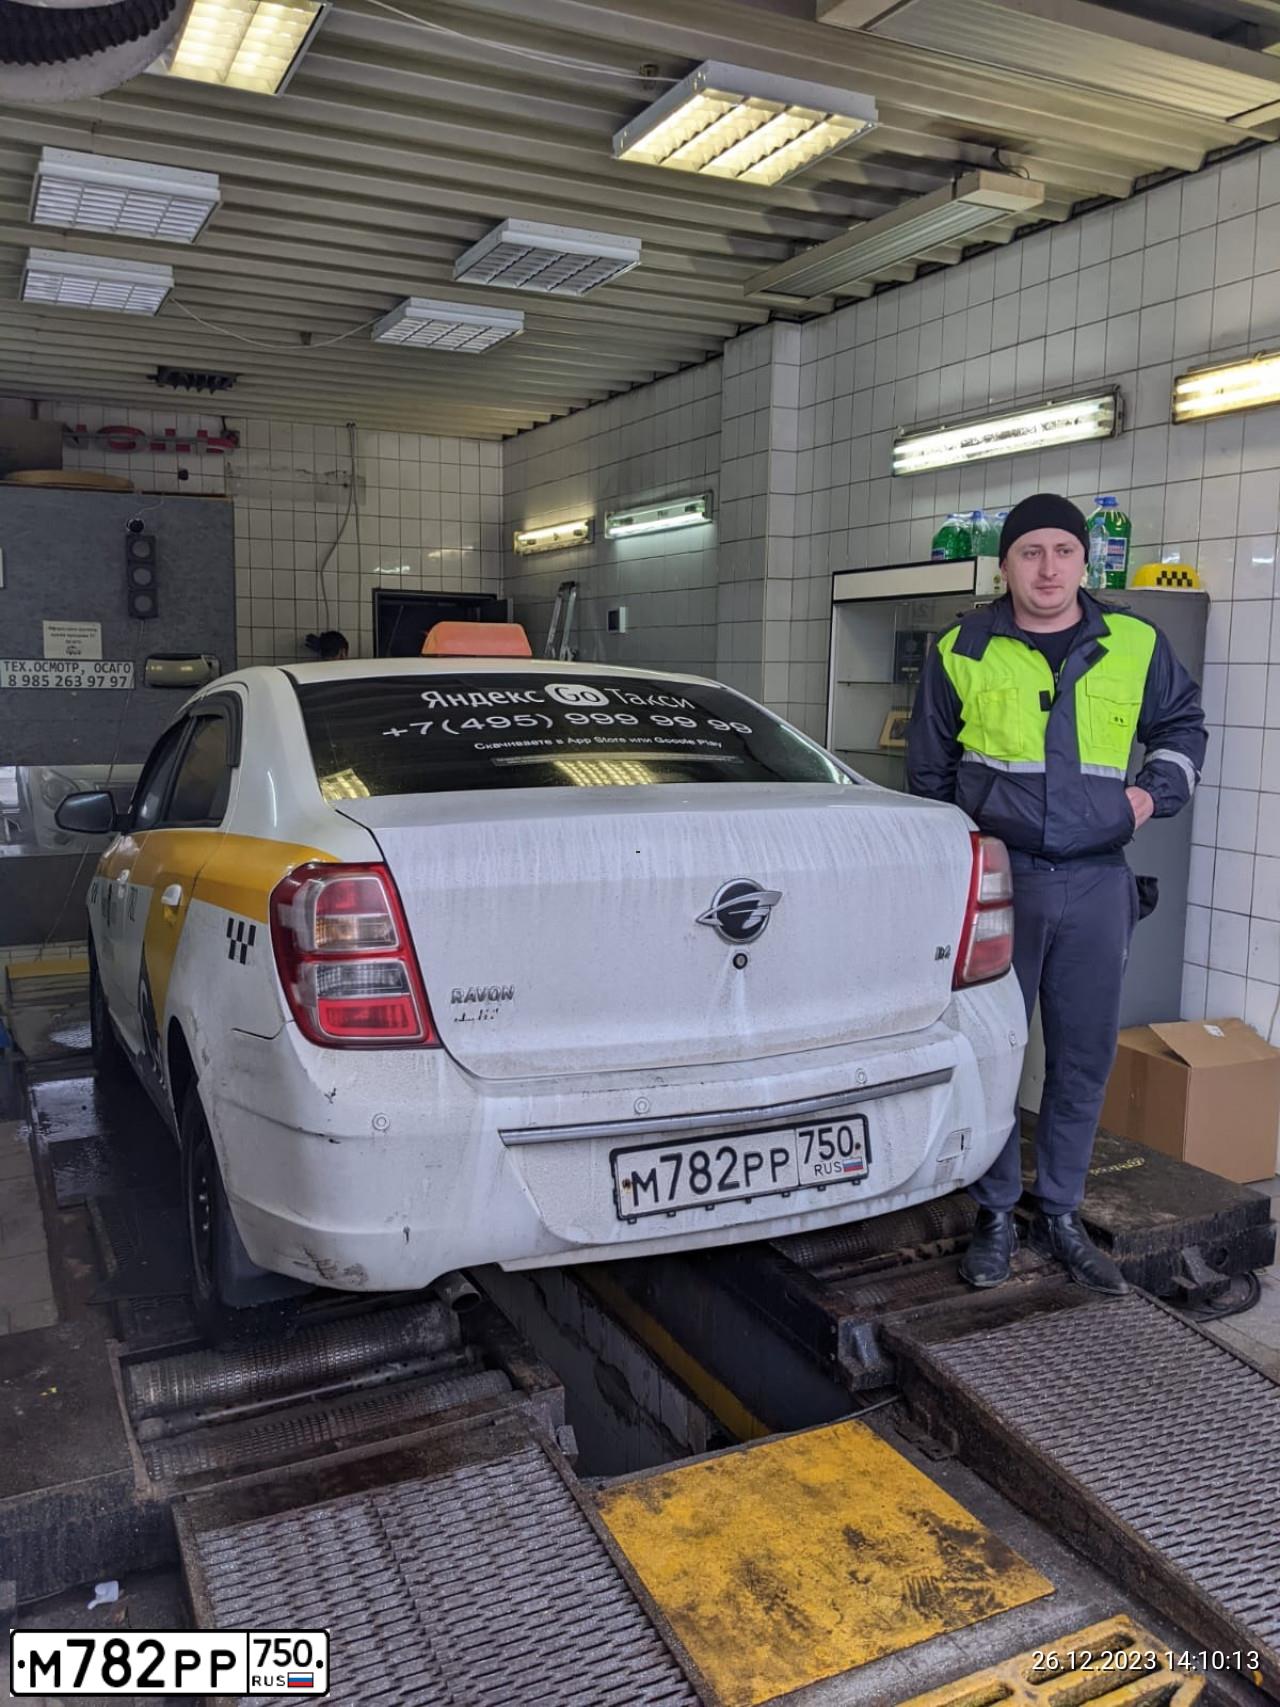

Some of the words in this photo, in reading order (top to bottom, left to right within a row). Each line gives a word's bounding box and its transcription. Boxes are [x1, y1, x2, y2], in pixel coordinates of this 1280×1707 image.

[4, 661, 86, 675] ТЕХ.ОСМОТР,
[94, 663, 131, 674] ОСАГО
[9, 675, 17, 687] 8
[22, 675, 49, 687] 985
[55, 675, 82, 687] 263
[88, 675, 104, 688] 97
[110, 675, 127, 688] 97
[420, 690, 545, 709] Яндекс
[553, 685, 601, 705] Go
[603, 687, 696, 710] Такси
[382, 713, 554, 737] +7(495)
[564, 712, 639, 725] 999
[650, 714, 698, 728] 99
[707, 718, 753, 734] 99
[567, 737, 592, 745] App
[593, 736, 627, 744] Store
[654, 736, 696, 745] Google
[696, 738, 722, 748] Play
[451, 984, 514, 1004] RAVON
[631, 1146, 790, 1207] М782РР
[798, 1125, 854, 1164] 750
[814, 1160, 843, 1177] RUS
